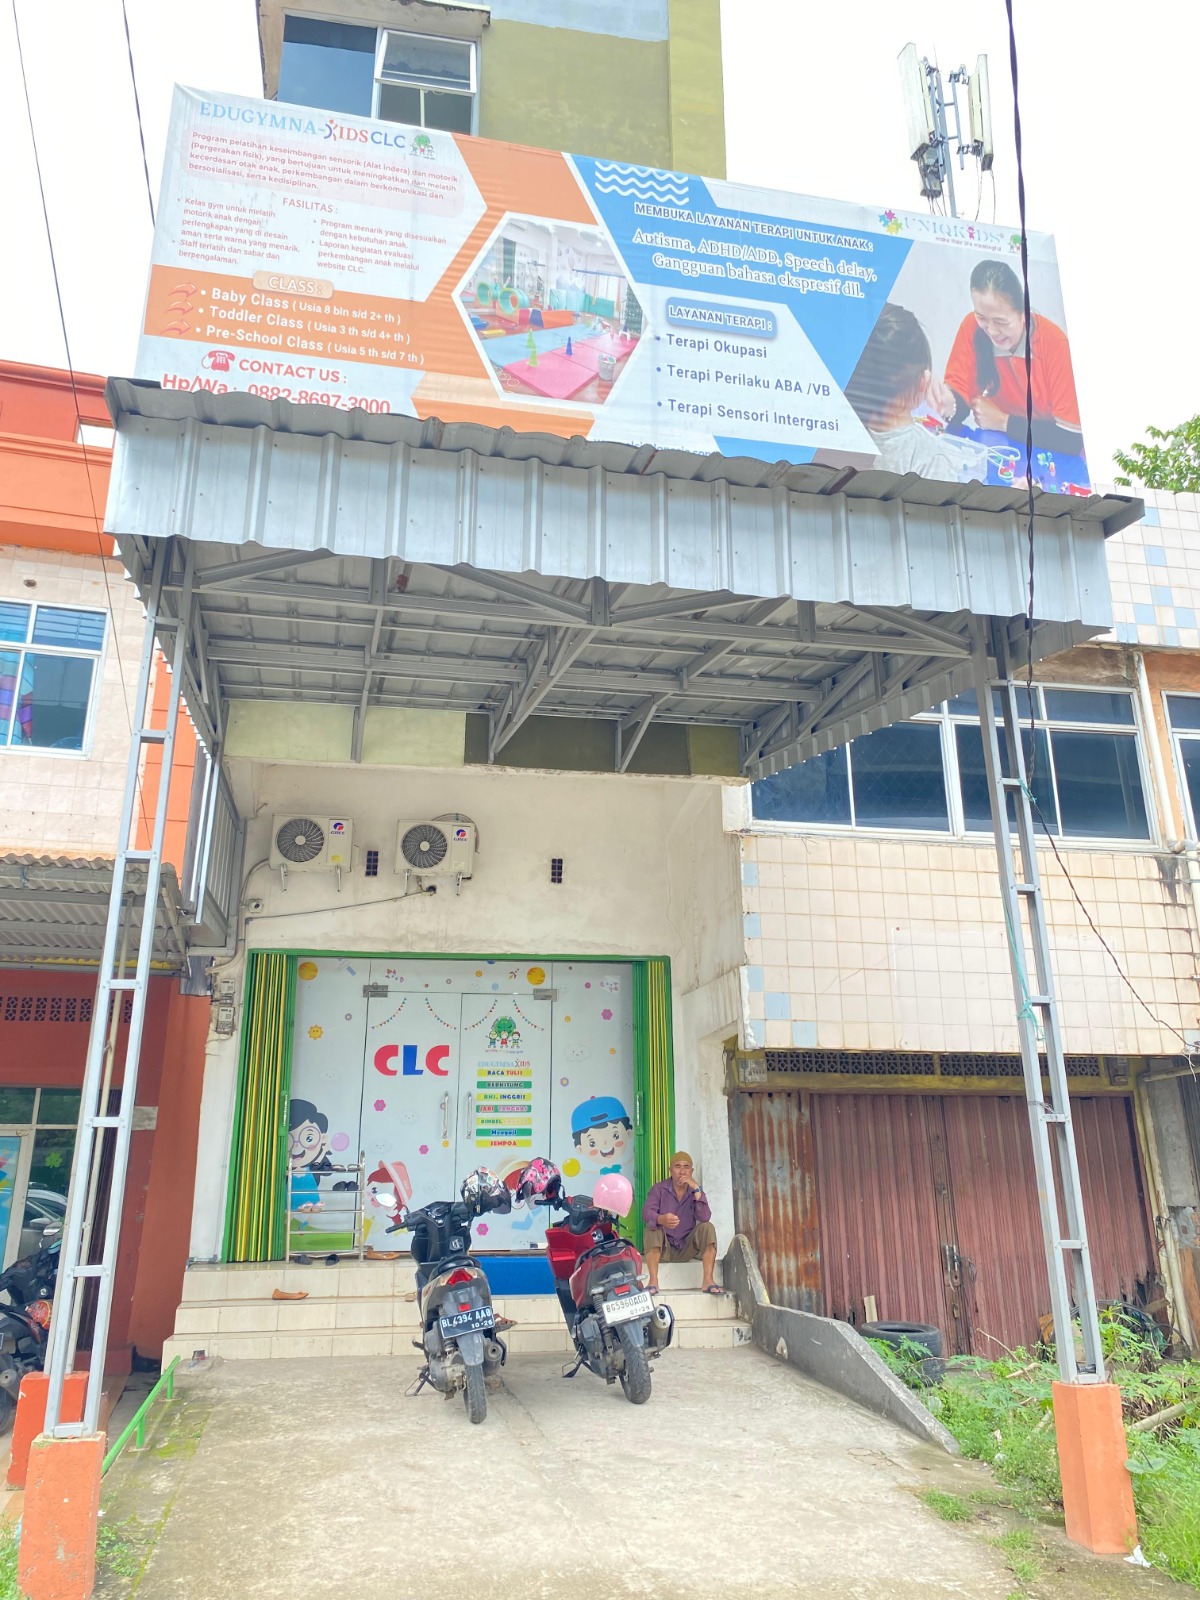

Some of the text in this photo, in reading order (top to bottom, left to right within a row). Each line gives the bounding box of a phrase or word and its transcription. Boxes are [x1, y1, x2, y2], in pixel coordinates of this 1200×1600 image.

[371, 131, 406, 148] CLC
[191, 141, 240, 156] (Pergerakan
[266, 155, 285, 165] yang
[287, 157, 326, 171] bertujuan
[329, 165, 351, 175] untuk
[354, 169, 409, 185] meningkatkan
[411, 179, 425, 187] dan
[427, 182, 456, 192] melatih
[192, 131, 458, 183] Program pelatihan keseimbangan sensorik (Alat indera) dan motorik
[189, 162, 319, 190] bersosialisasi, serta kedisiplinan.
[190, 152, 444, 200] kecerdasan otak anak, perkembangan dalam berkomunikasi dan
[183, 208, 261, 226] motorik anak dengan
[185, 197, 276, 218] Kelas gym untuk melatih
[282, 197, 333, 213] FASILITAS
[182, 219, 233, 232] perlengkapan
[235, 226, 253, 237] yang
[264, 231, 288, 240] desain
[320, 219, 447, 245] Program menarik yang disesuaikan
[635, 203, 694, 222] MEMBUKA
[696, 213, 750, 232] LAYANAN
[753, 223, 793, 238] TERAPI
[796, 230, 834, 245] UNTUK
[836, 236, 866, 250] ANAK
[180, 239, 280, 260] Staff terlatih dan sabar dan
[181, 230, 300, 252] aman serta warna yang menarik.
[319, 239, 414, 260] Laporan kegiatan evaluasi
[320, 229, 408, 249] dengan kebutuhan anak.
[178, 249, 239, 265] berpengalaman.
[317, 261, 346, 271] website
[318, 251, 420, 271] perkembangan anak melalui
[633, 230, 877, 281] Autisma, ADHD/ADD, Speech delay,
[268, 276, 314, 293] CLASS
[653, 254, 864, 297] Gangguan bahasa ekspresif dll.
[211, 288, 246, 306] Baby
[251, 293, 289, 310] Class
[299, 302, 322, 314] Usia
[324, 305, 331, 314] 8
[333, 306, 349, 317] bln
[352, 308, 367, 319] s/d
[369, 311, 382, 321] 2+
[384, 313, 395, 323] th
[669, 306, 723, 323] LAYANAN
[726, 314, 765, 329] TERAPI
[210, 305, 262, 324] Toddler
[266, 313, 304, 329] Class
[314, 321, 337, 334] Usia
[339, 325, 346, 335] 3
[348, 326, 358, 337] th
[361, 328, 377, 339] s/d
[379, 331, 391, 340] 4+
[393, 333, 403, 343] th
[206, 325, 282, 346] Pre-School
[286, 336, 323, 351] Class
[334, 343, 357, 355] Usia
[359, 347, 366, 356] 5
[368, 348, 379, 358] th
[381, 350, 397, 360] s/d
[399, 352, 406, 361] 7
[408, 353, 418, 363] th
[666, 333, 767, 358] Terapi Okupasi
[239, 359, 316, 380] CONTACT
[319, 368, 340, 383] US
[667, 364, 711, 383] Terapi
[715, 370, 770, 389] Perilaku
[774, 378, 803, 394] ABA
[667, 398, 839, 432] Terapi Sensori Intergrasi
[374, 1044, 450, 1076] CLC
